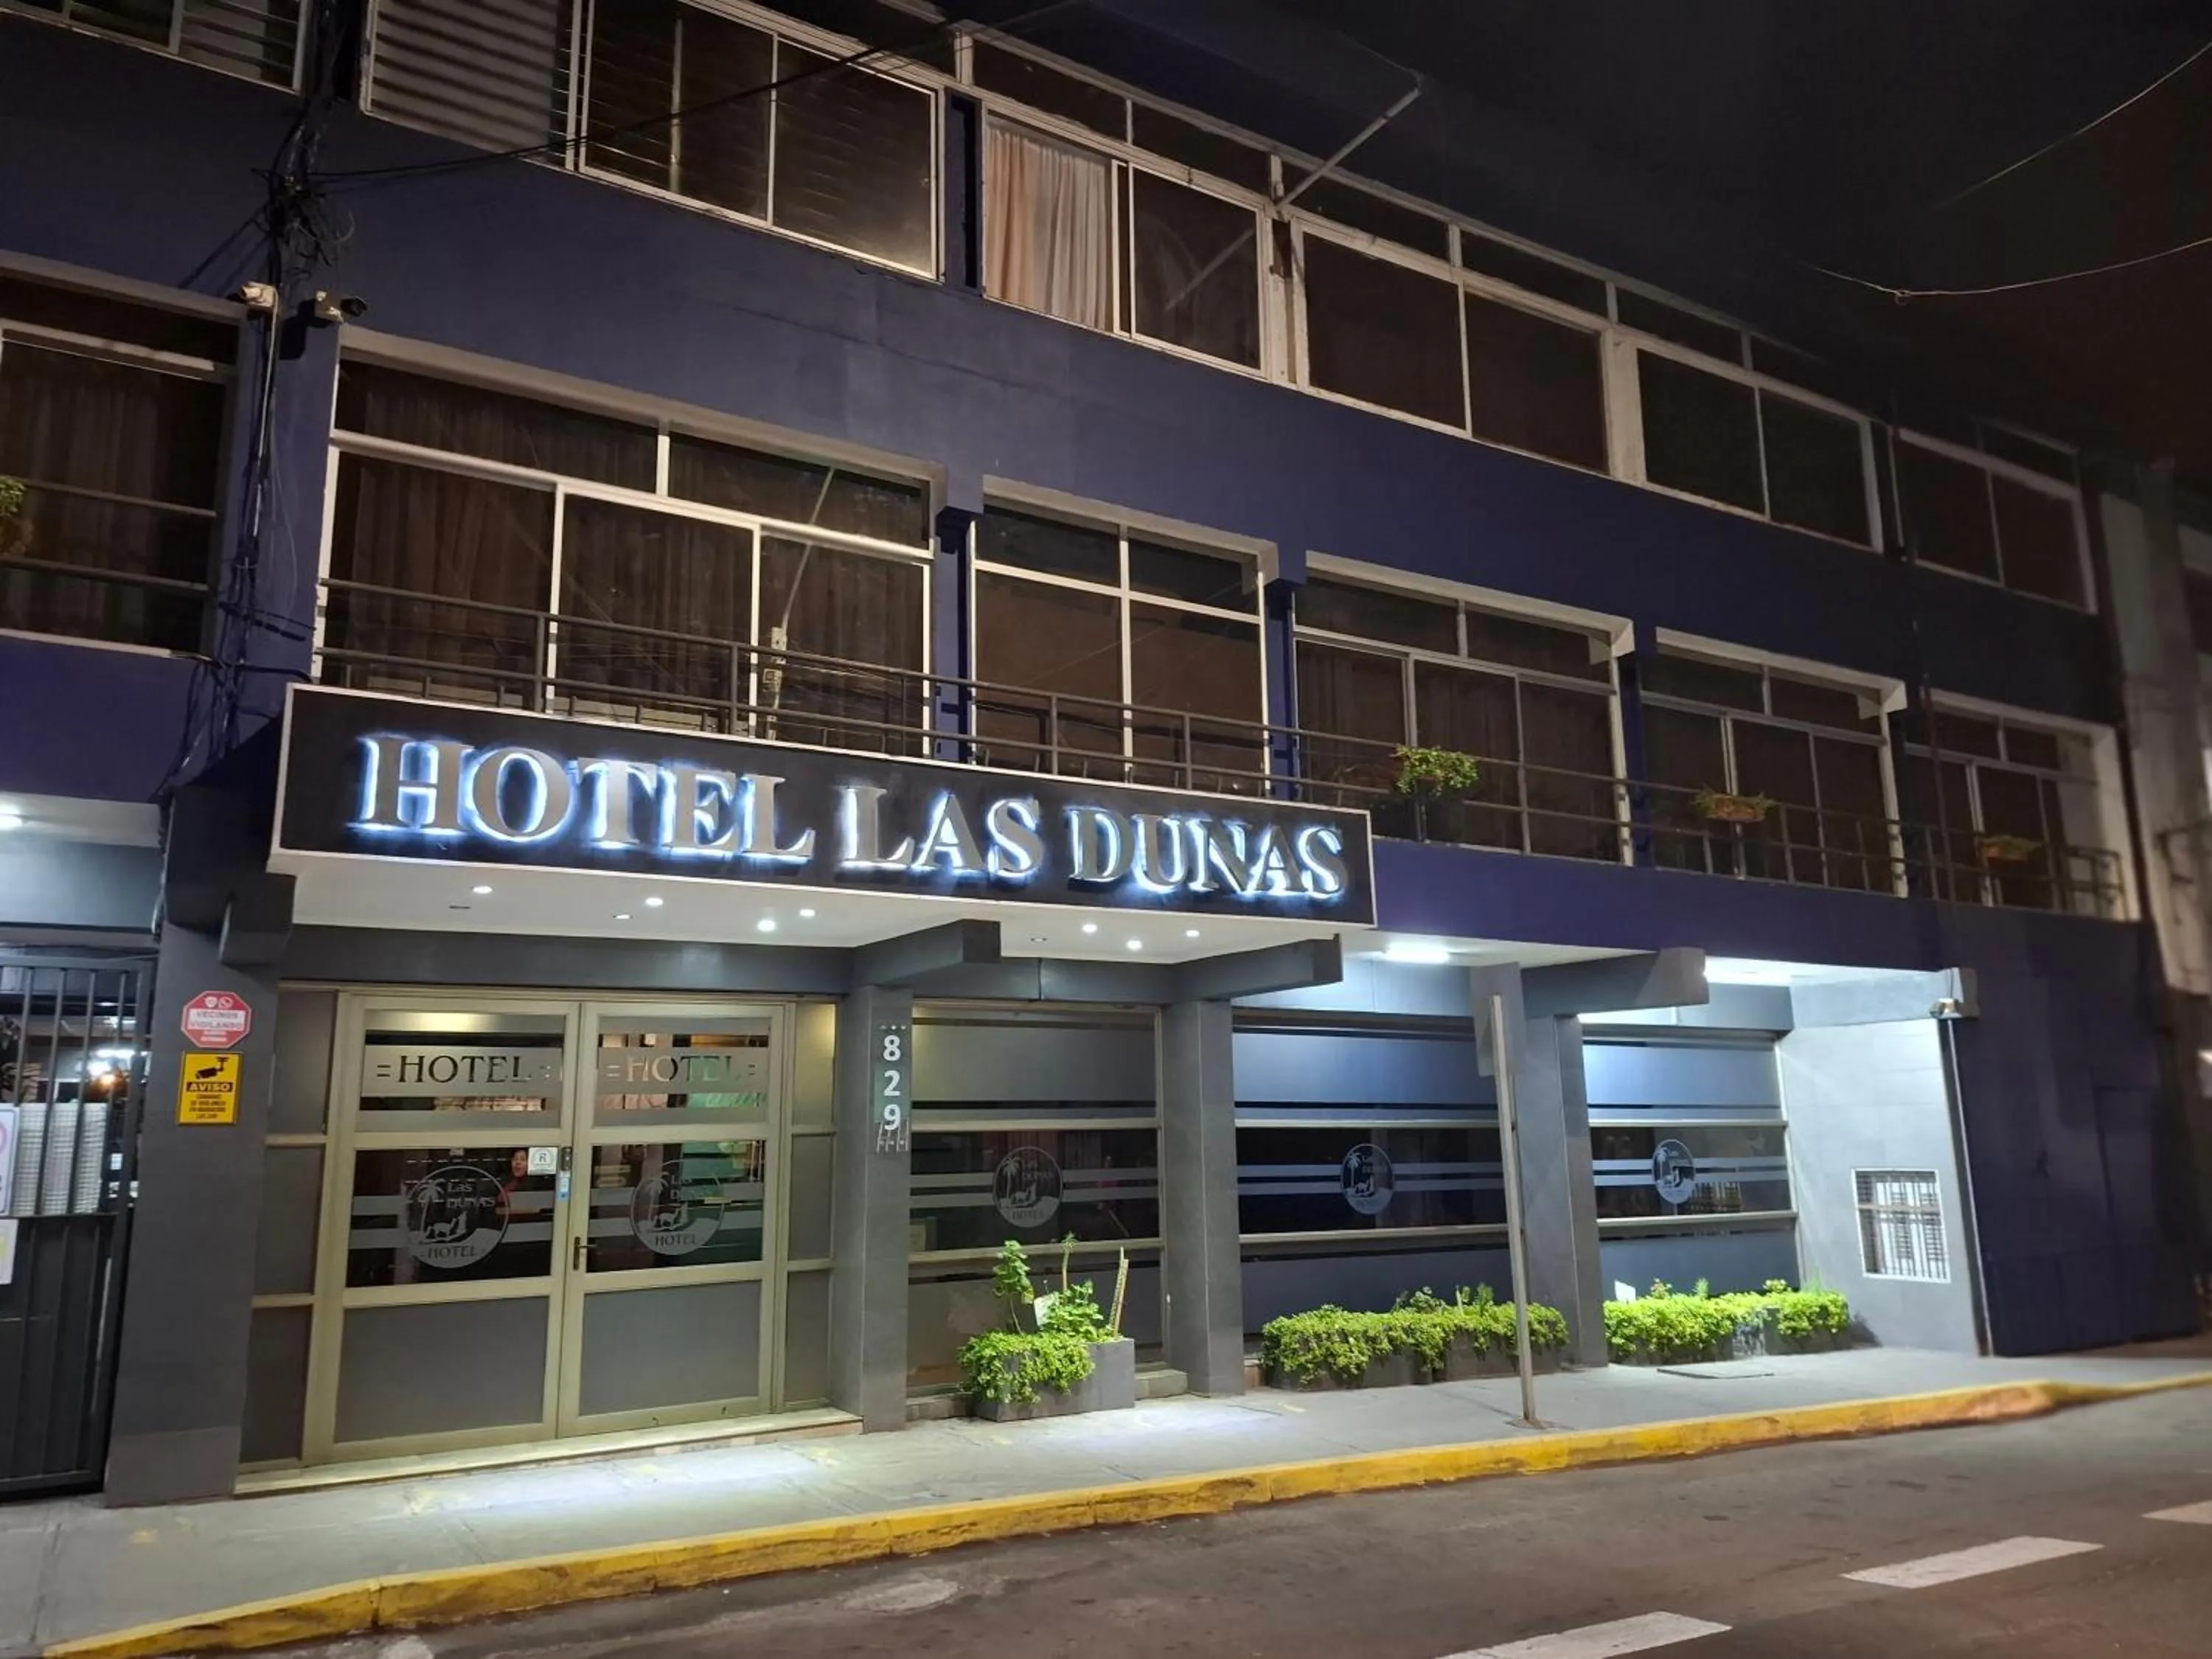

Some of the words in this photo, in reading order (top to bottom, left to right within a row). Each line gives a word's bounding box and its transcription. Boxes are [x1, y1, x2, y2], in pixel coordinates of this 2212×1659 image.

[351, 736, 815, 861] HOTEL
[839, 785, 1044, 878] LAS
[1065, 805, 1349, 899] DUNAS
[397, 1055, 532, 1083] HOTEL
[627, 1055, 742, 1082] HOTEL
[189, 1082, 231, 1091] AVISO
[655, 1234, 697, 1247] HOTEL
[427, 1245, 476, 1259] HOTEL
